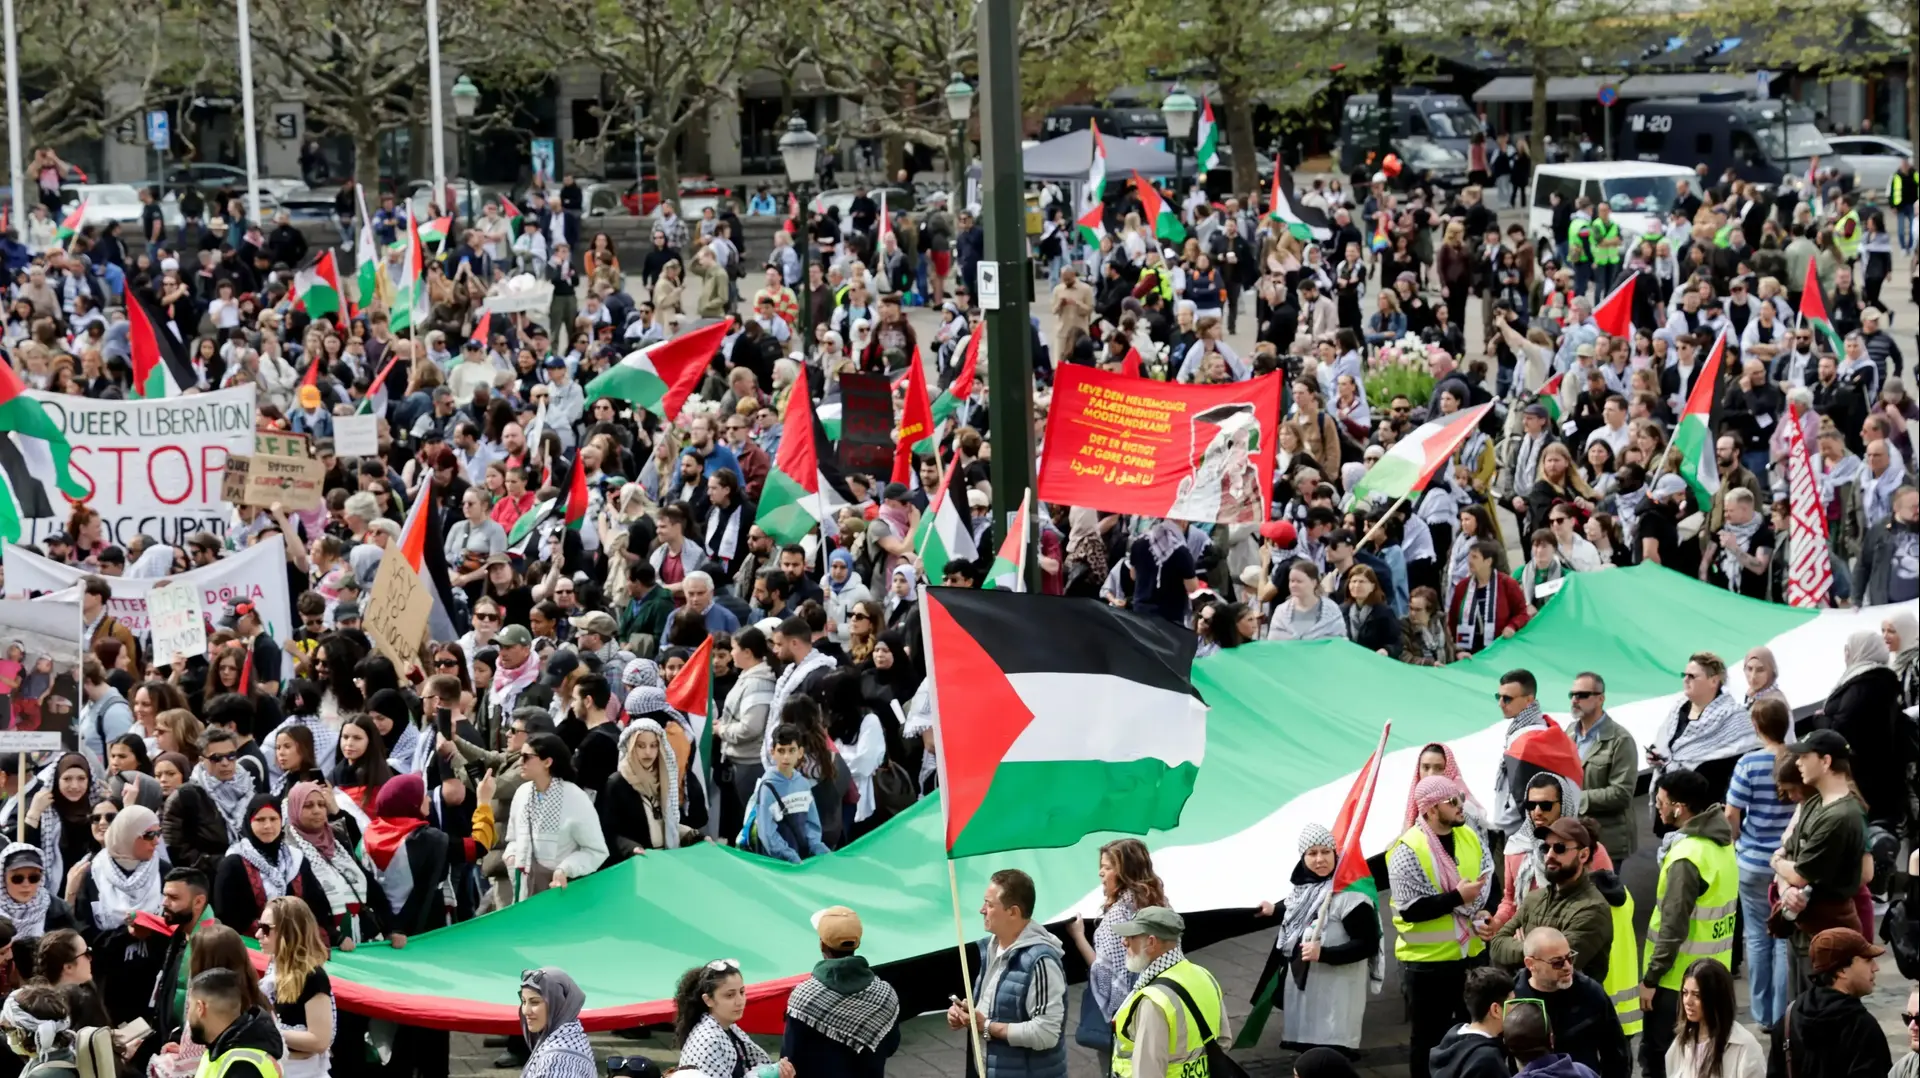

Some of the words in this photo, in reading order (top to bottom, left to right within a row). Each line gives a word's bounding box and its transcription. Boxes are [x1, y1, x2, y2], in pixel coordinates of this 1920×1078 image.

[1078, 382, 1103, 397] LEVE
[1103, 389, 1124, 402] DEN
[137, 400, 250, 437] LIBERATION
[1079, 445, 1094, 456] AT
[1089, 433, 1108, 445] DET
[1108, 438, 1120, 449] ER
[61, 444, 229, 505] STOP
[101, 516, 231, 548] CCUPATI
